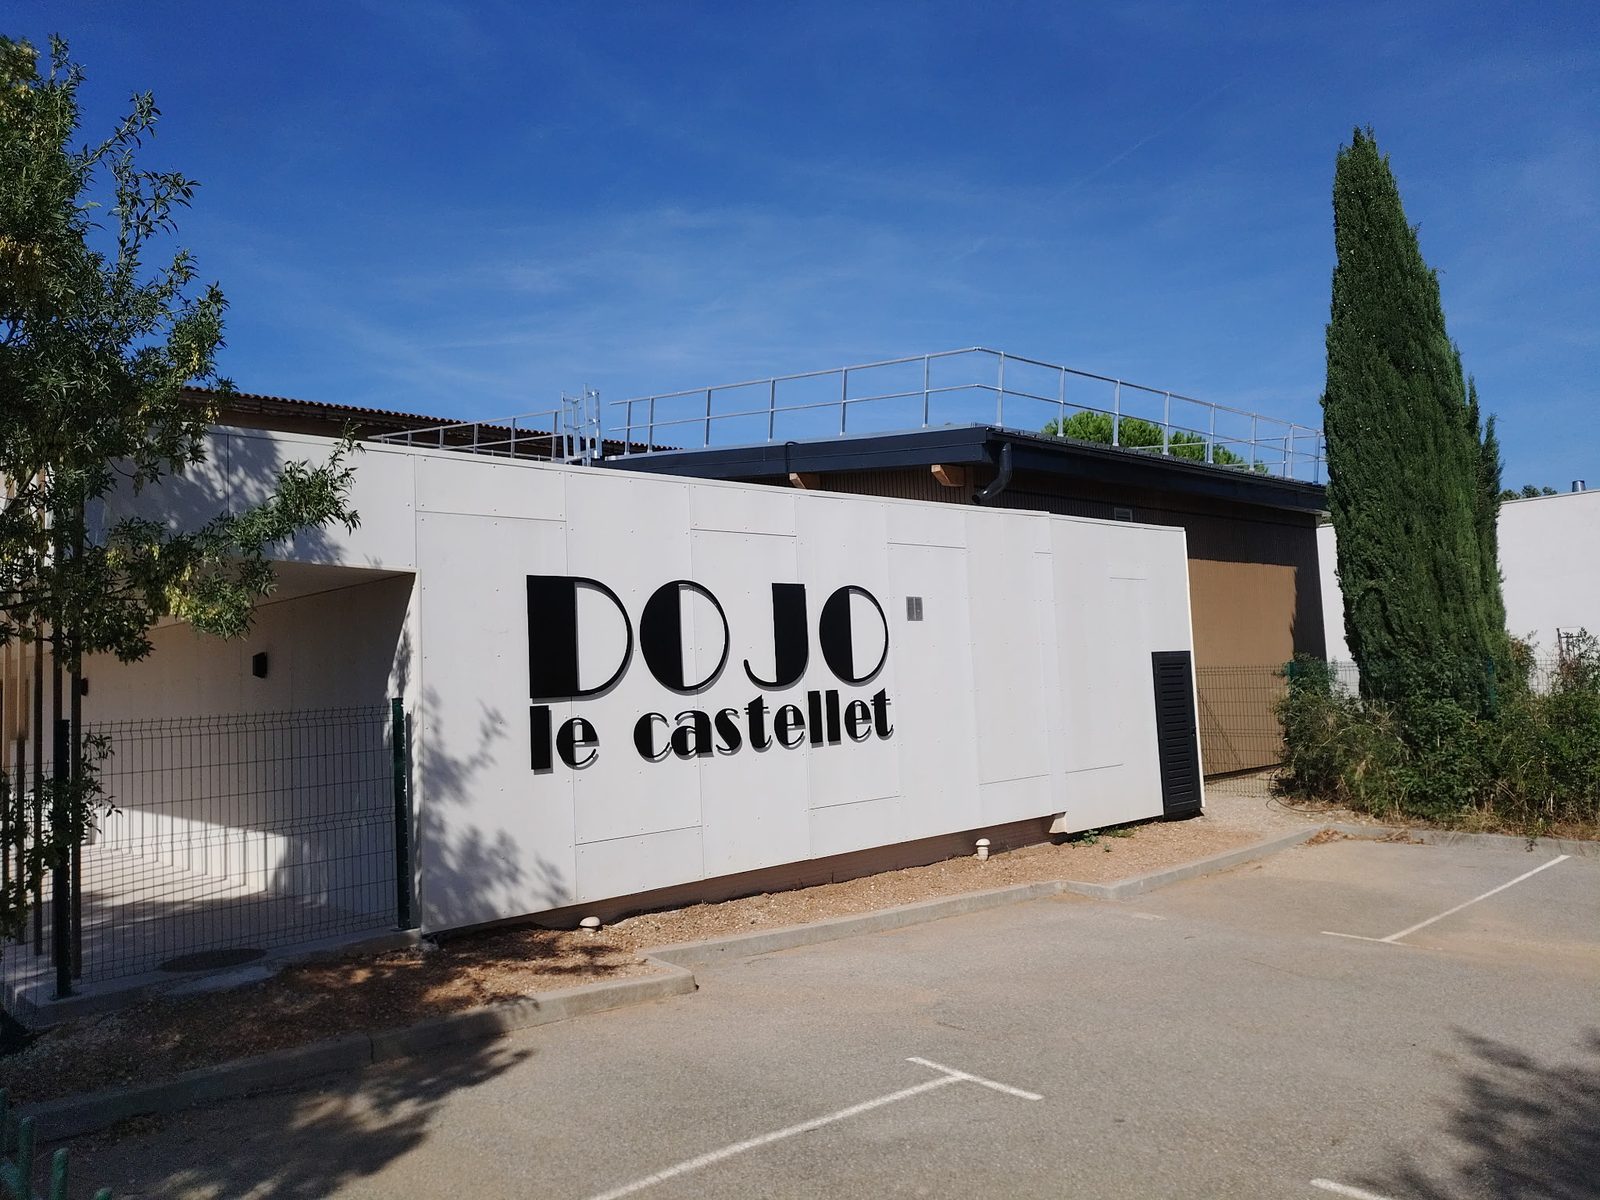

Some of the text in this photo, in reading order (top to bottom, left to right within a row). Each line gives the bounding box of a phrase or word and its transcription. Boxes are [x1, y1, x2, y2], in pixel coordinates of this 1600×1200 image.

[526, 574, 889, 700] DOJO
[529, 687, 894, 772] le castellet
